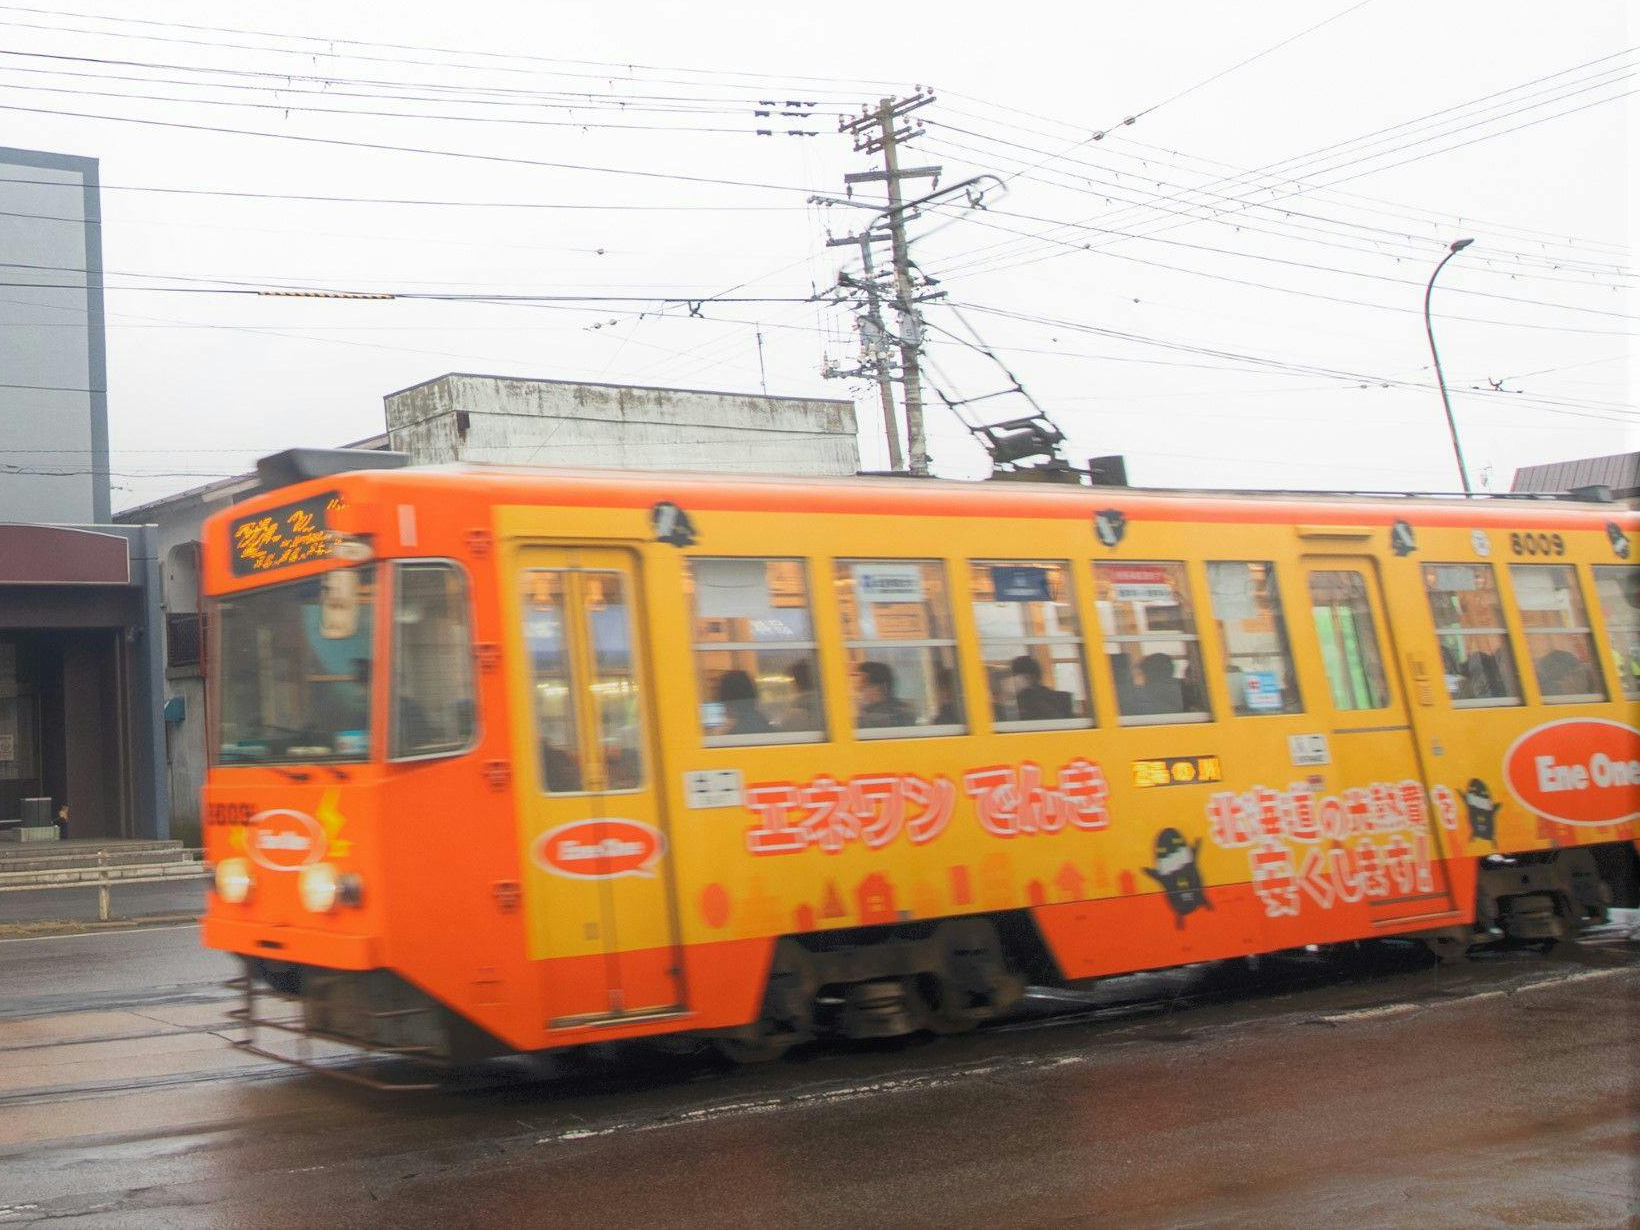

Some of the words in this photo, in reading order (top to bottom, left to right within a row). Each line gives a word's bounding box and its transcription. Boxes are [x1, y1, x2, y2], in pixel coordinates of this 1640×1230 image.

[1511, 532, 1564, 555] 8009
[1534, 755, 1590, 792] Ene
[1589, 751, 1640, 788] One
[743, 772, 956, 857] エネワン
[962, 755, 1111, 839] でんき
